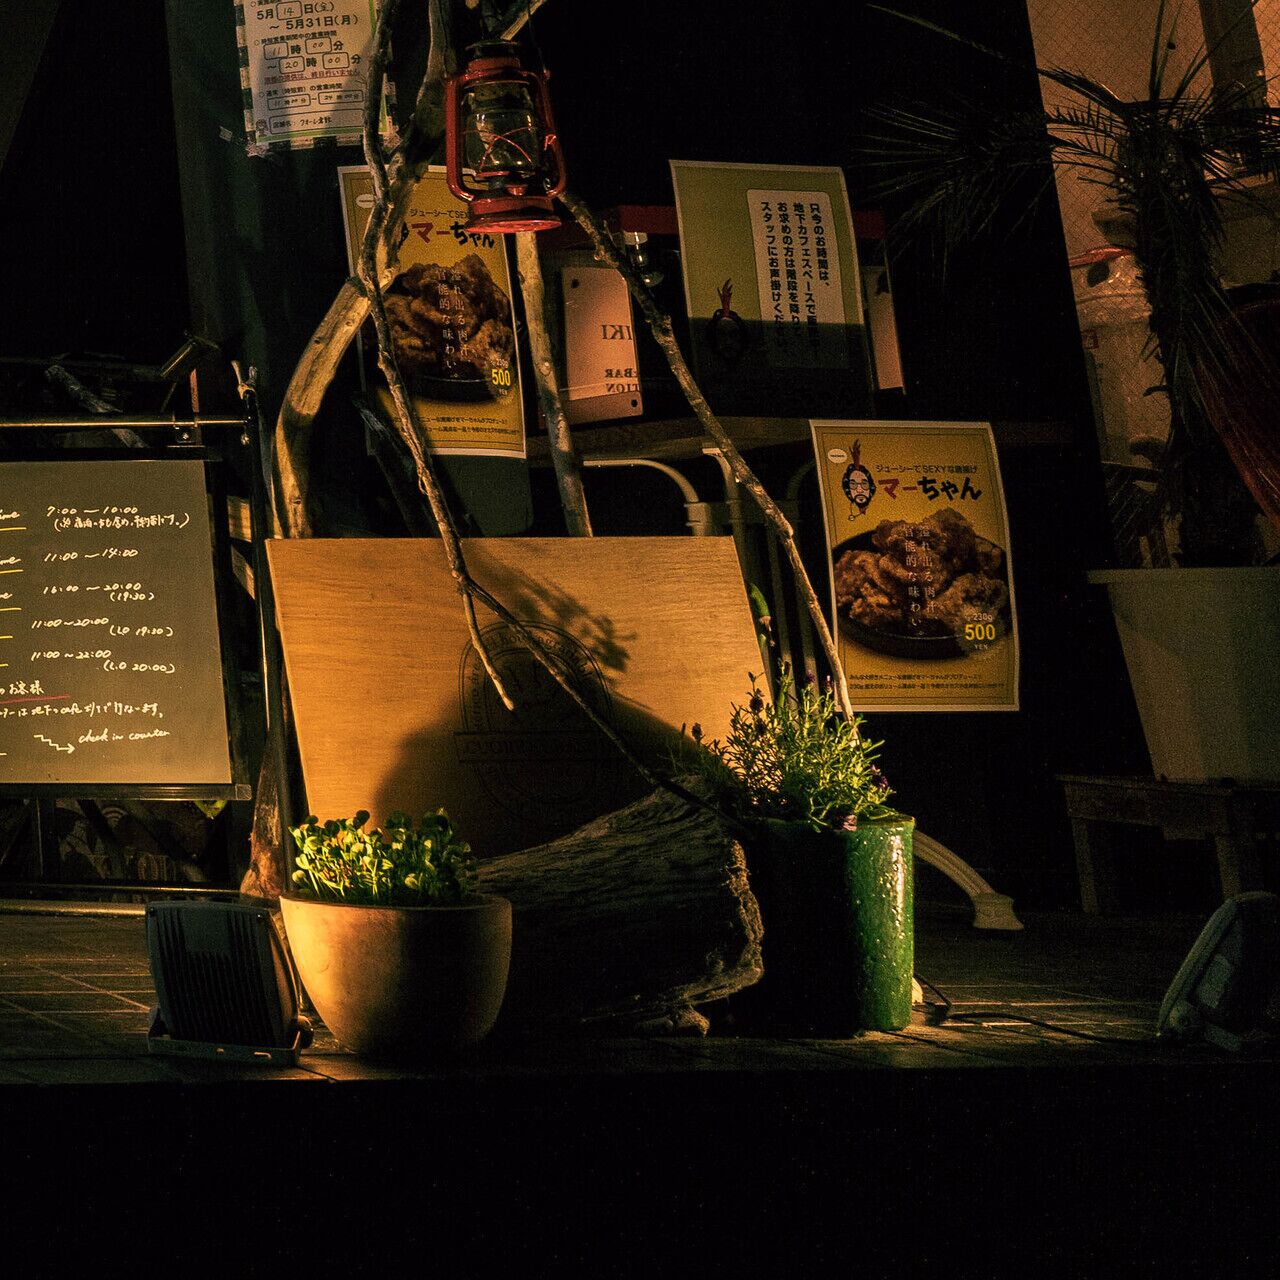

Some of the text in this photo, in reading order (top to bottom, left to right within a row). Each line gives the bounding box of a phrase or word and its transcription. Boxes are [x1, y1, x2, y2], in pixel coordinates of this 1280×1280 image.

[256, 8, 274, 20] 5月
[411, 220, 495, 249] マーちゃん
[810, 203, 831, 287] 只今のお時間は、
[491, 368, 511, 387] 500
[877, 476, 983, 502] マーちゃん
[46, 504, 78, 517] 7:00
[103, 504, 139, 516] 10:00
[44, 551, 78, 562] 11:00
[102, 548, 139, 559] 14:00
[43, 584, 79, 595] 16:00
[104, 582, 142, 592] 20:00
[964, 623, 996, 641] 500
[78, 728, 109, 744] check
[112, 733, 124, 742] in
